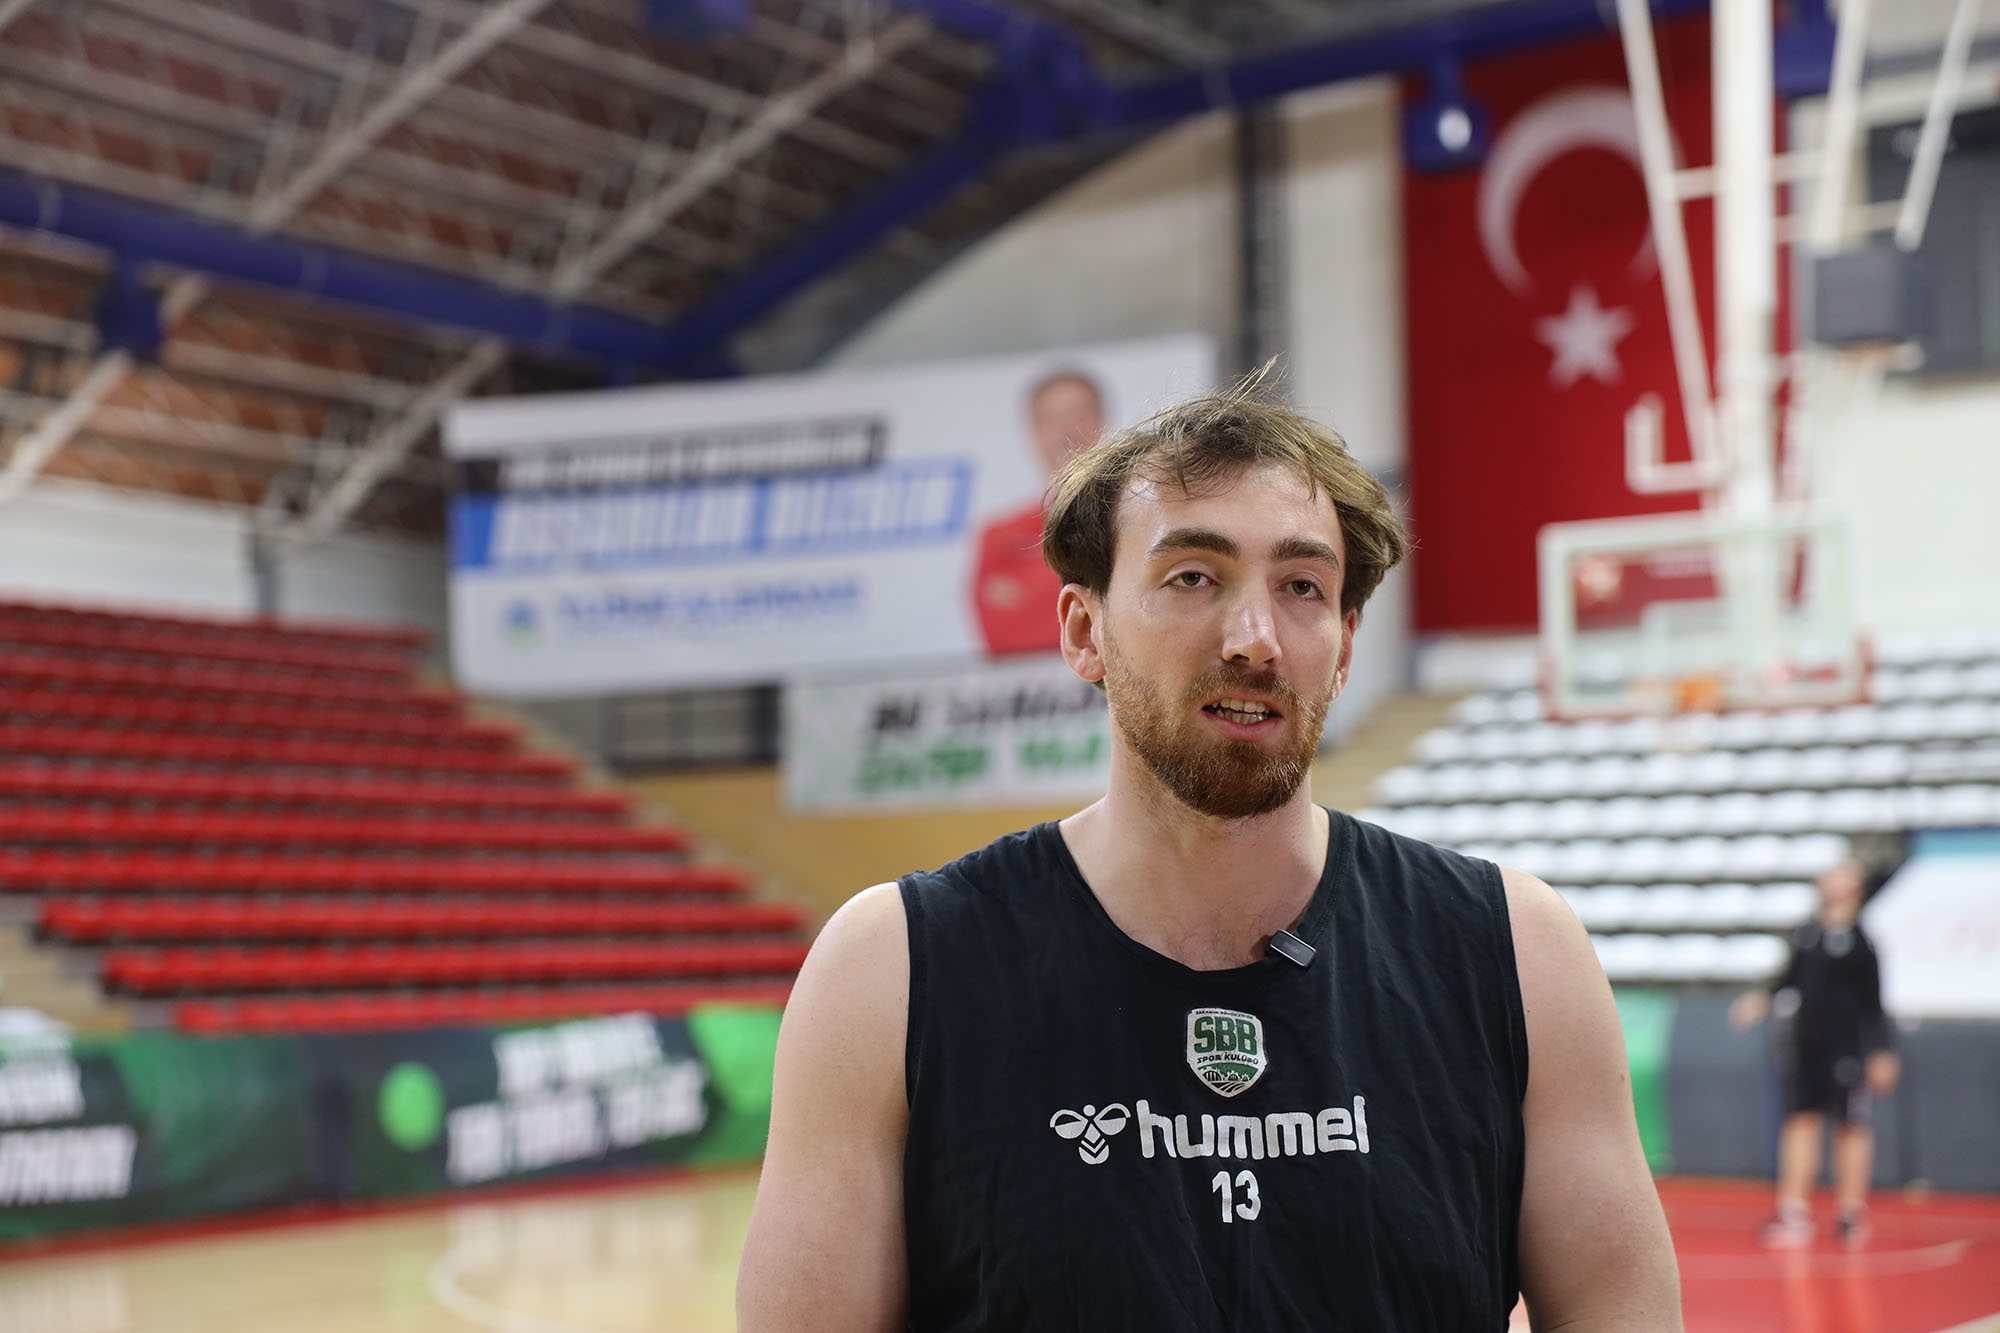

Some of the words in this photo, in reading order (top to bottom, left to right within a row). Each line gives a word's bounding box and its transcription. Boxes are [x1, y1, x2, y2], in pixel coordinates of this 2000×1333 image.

[1194, 1016, 1258, 1056] SBB
[1197, 1054, 1222, 1064] SPOR
[1136, 1095, 1370, 1159] hummel
[1212, 1170, 1262, 1223] 13
